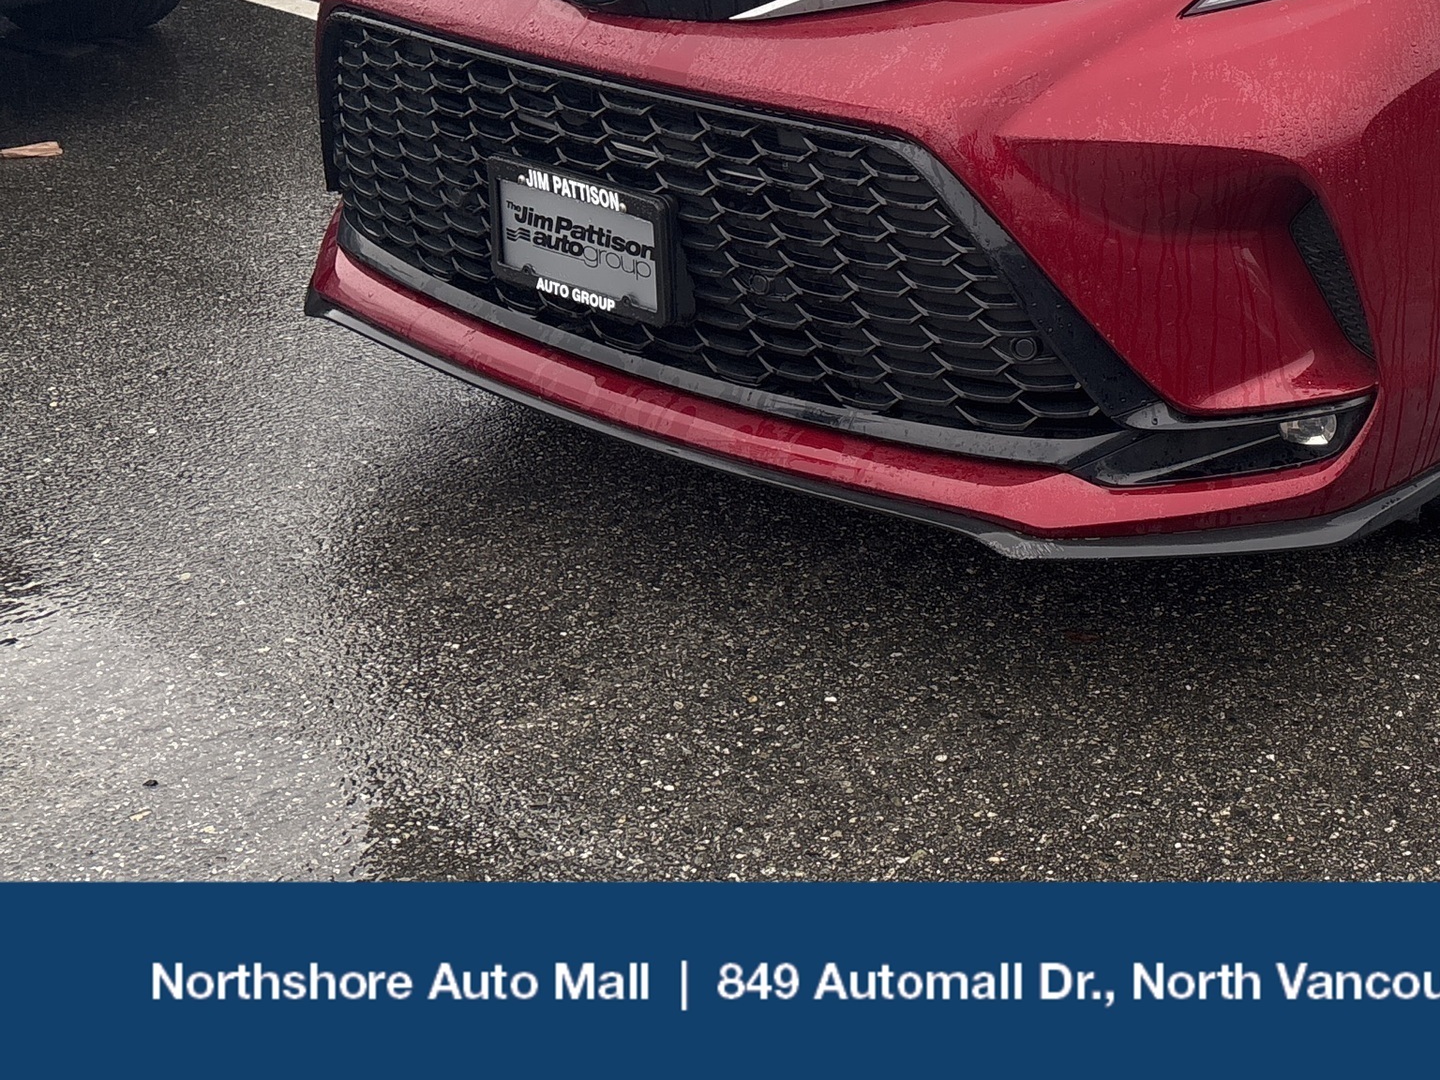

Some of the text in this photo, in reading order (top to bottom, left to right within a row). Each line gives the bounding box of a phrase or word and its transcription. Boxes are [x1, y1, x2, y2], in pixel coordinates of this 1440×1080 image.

[506, 200, 522, 213] The
[526, 169, 621, 212] JIM PATTISON
[536, 277, 616, 312] AUTO GROUP
